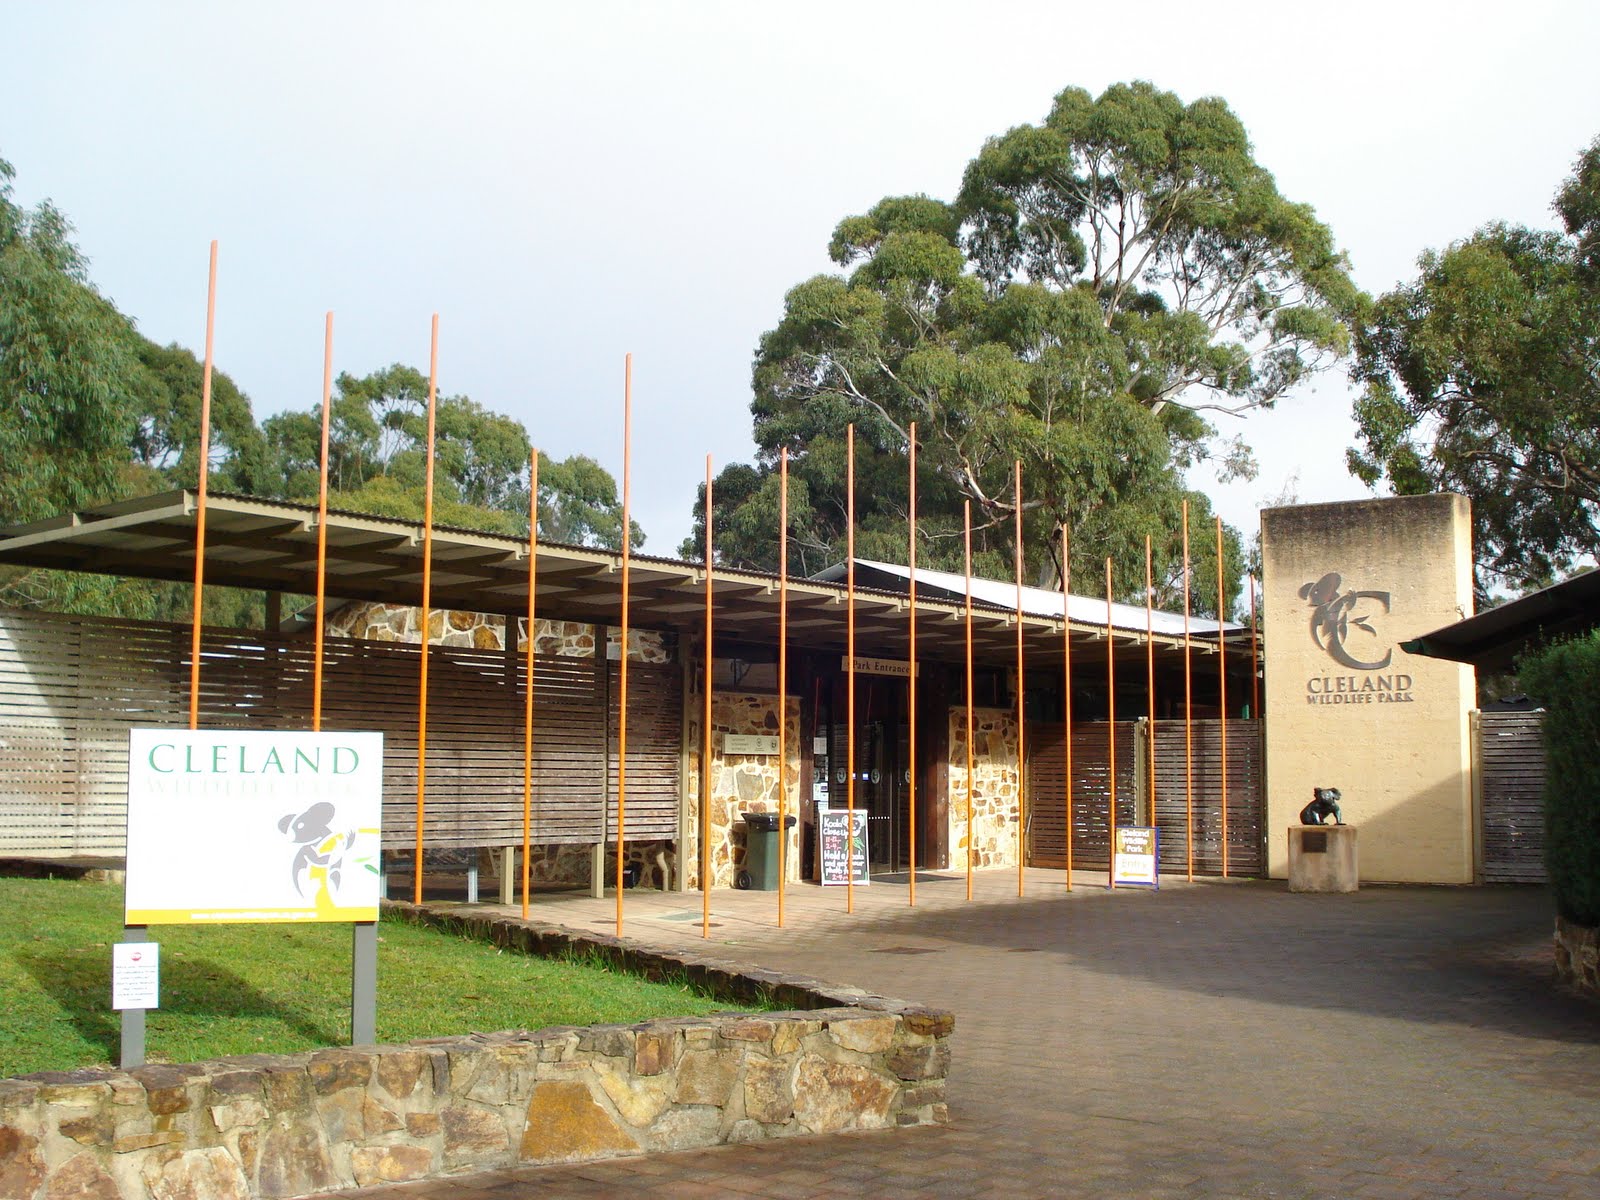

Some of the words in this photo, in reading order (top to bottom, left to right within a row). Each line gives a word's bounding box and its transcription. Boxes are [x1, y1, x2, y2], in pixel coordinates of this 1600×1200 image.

[852, 660, 871, 671] Park
[875, 662, 910, 674] Entrance
[1306, 674, 1413, 694] CLELAND
[1307, 692, 1372, 705] WILDLIFE
[1377, 691, 1414, 703] PARK
[148, 744, 360, 775] CLELAND
[824, 817, 843, 828] Koala
[1120, 829, 1150, 838] Cleland
[824, 850, 841, 860] Hold
[1126, 845, 1144, 853] Park
